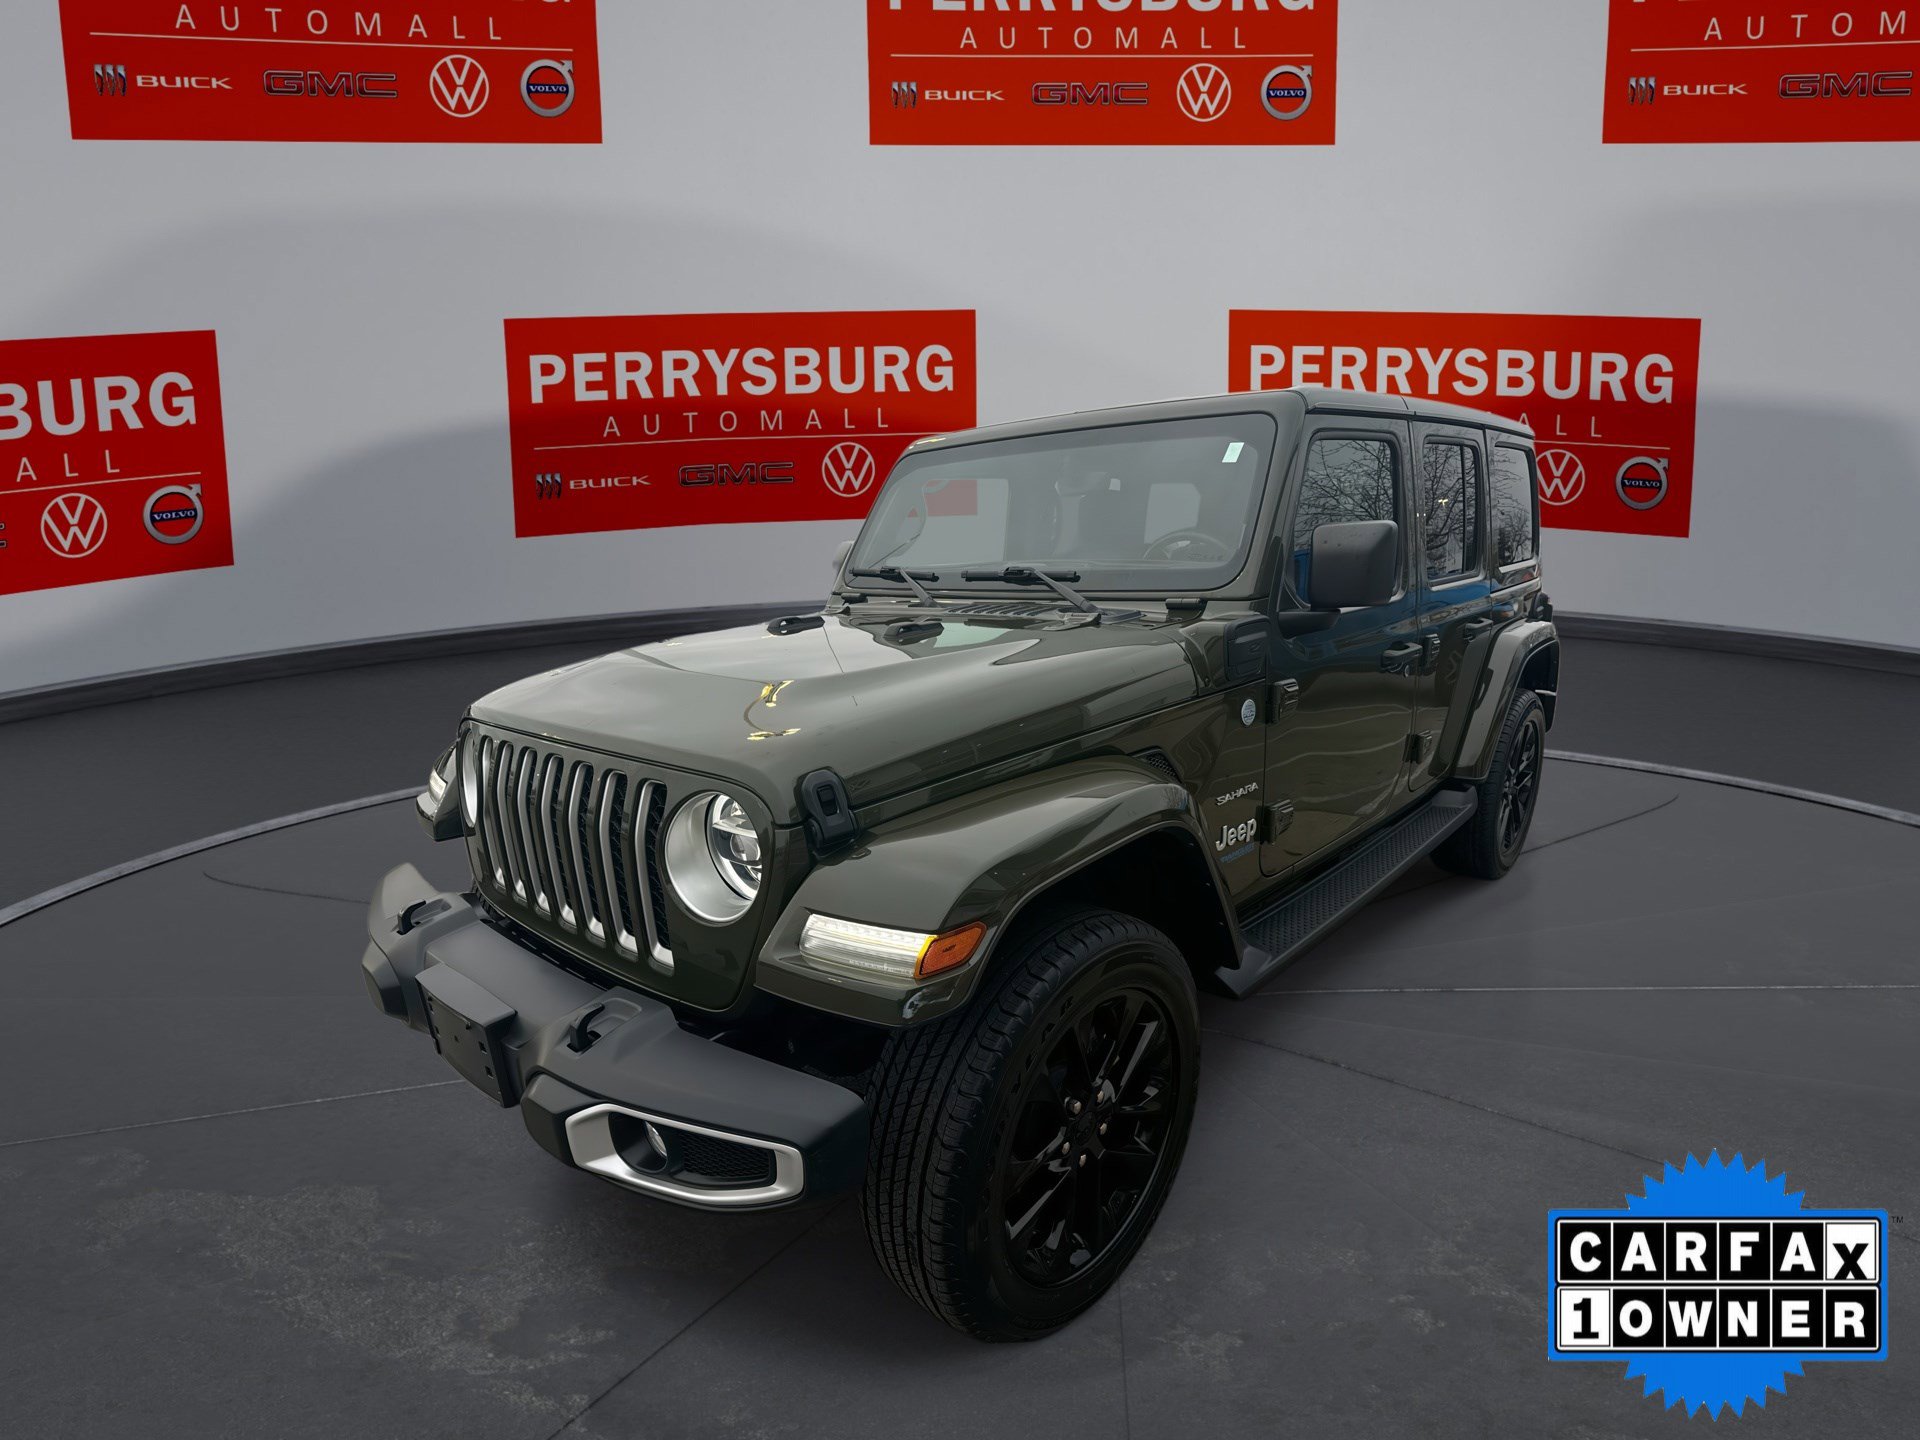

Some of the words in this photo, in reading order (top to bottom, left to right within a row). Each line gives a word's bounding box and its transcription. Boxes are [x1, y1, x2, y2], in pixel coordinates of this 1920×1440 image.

[175, 4, 502, 41] AUTOMALL
[1703, 9, 1907, 41] AUTOM
[959, 26, 1247, 50] AUTOMALL
[135, 74, 233, 90] BUICK
[262, 69, 398, 98] GMC
[528, 82, 569, 95] VOLVO
[1031, 81, 1149, 106] GMC
[1268, 88, 1305, 98] VOLVO
[1662, 83, 1748, 96] BUICK
[1778, 71, 1913, 99] GMC
[924, 89, 1005, 101] BUICK
[528, 344, 955, 405] PERRYSBURG
[1249, 344, 1675, 404] PERRYSBURG
[603, 407, 889, 438] AUTOMALL
[569, 475, 651, 490] BUICK
[678, 461, 795, 486] GMC
[1622, 478, 1661, 488] VOLVO
[152, 508, 196, 521] VOLVO
[1216, 782, 1259, 806] SAHARA
[1215, 818, 1258, 852] Jeep
